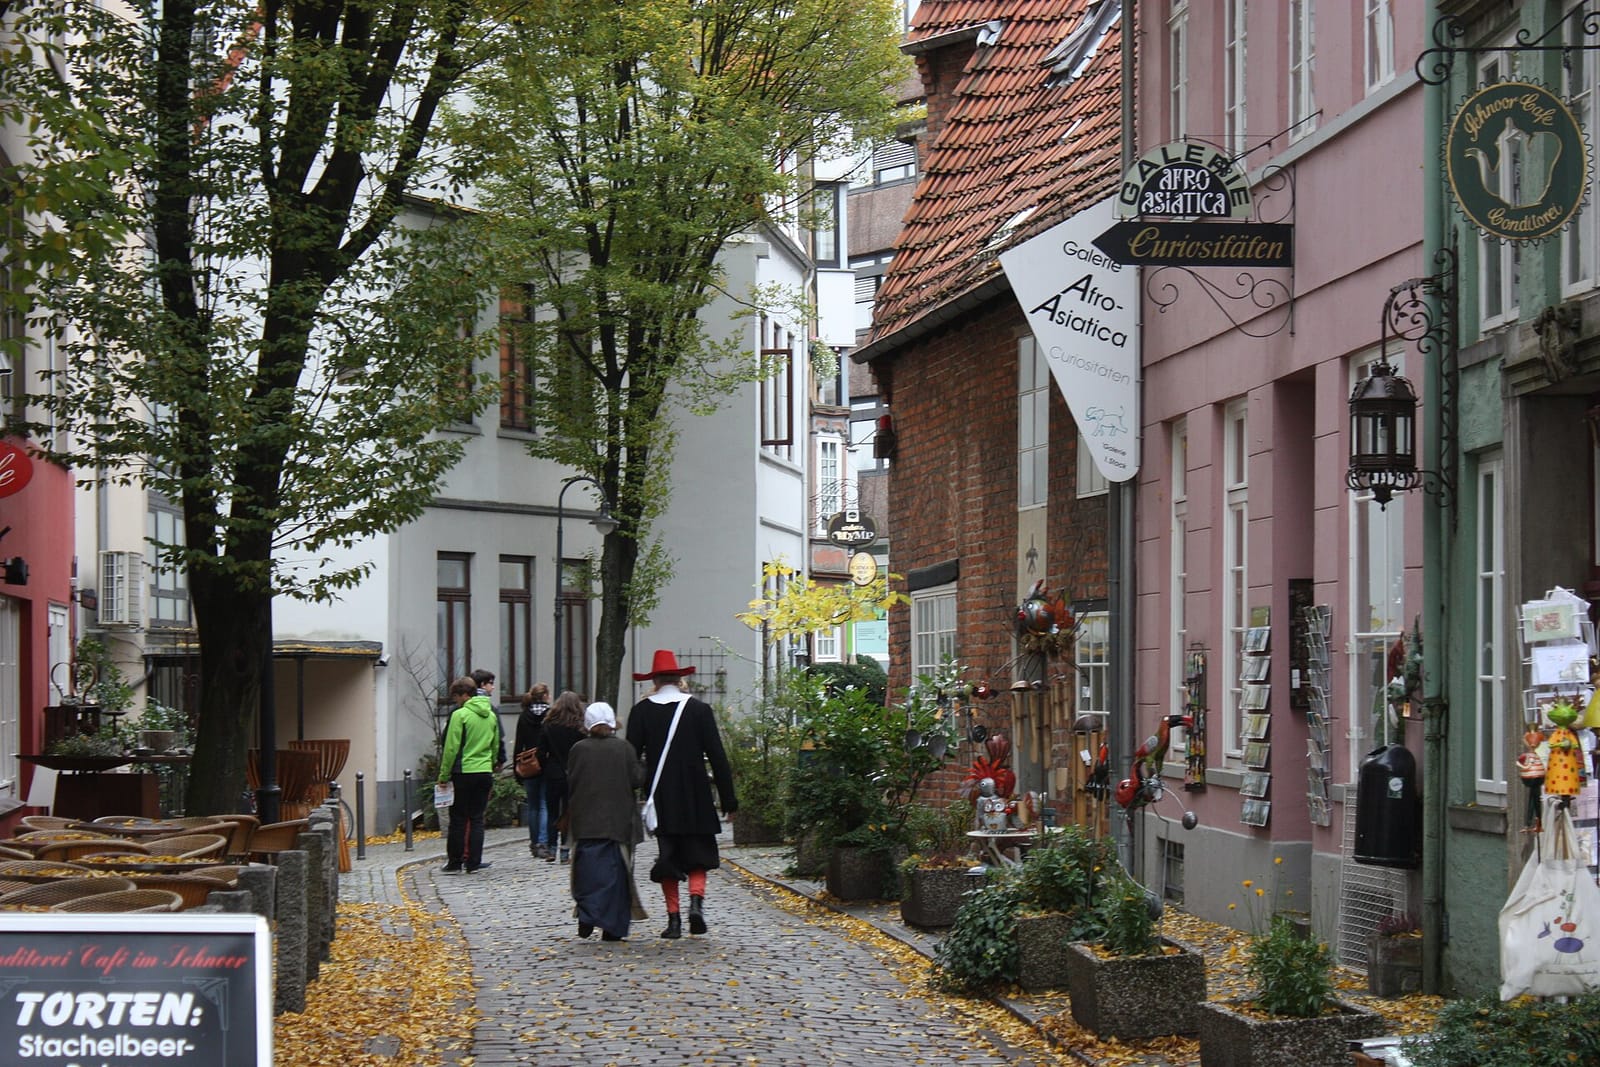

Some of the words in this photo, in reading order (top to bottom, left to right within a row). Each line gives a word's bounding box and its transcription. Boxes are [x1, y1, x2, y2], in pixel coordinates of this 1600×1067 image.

[1463, 96, 1518, 142] Schnoor
[1120, 144, 1249, 207] GALERIE
[1158, 168, 1211, 191] AFRO
[1487, 204, 1563, 232] Conditorei
[1063, 240, 1122, 273] Galerie
[1127, 226, 1284, 260] Curiositäten
[1060, 274, 1124, 312] Afro-
[1029, 294, 1128, 348] Asiatica
[131, 951, 159, 968] im
[163, 944, 248, 969] Schnoor
[16, 991, 203, 1029] TORTEN:
[18, 1034, 195, 1057] Stachelbeer-
